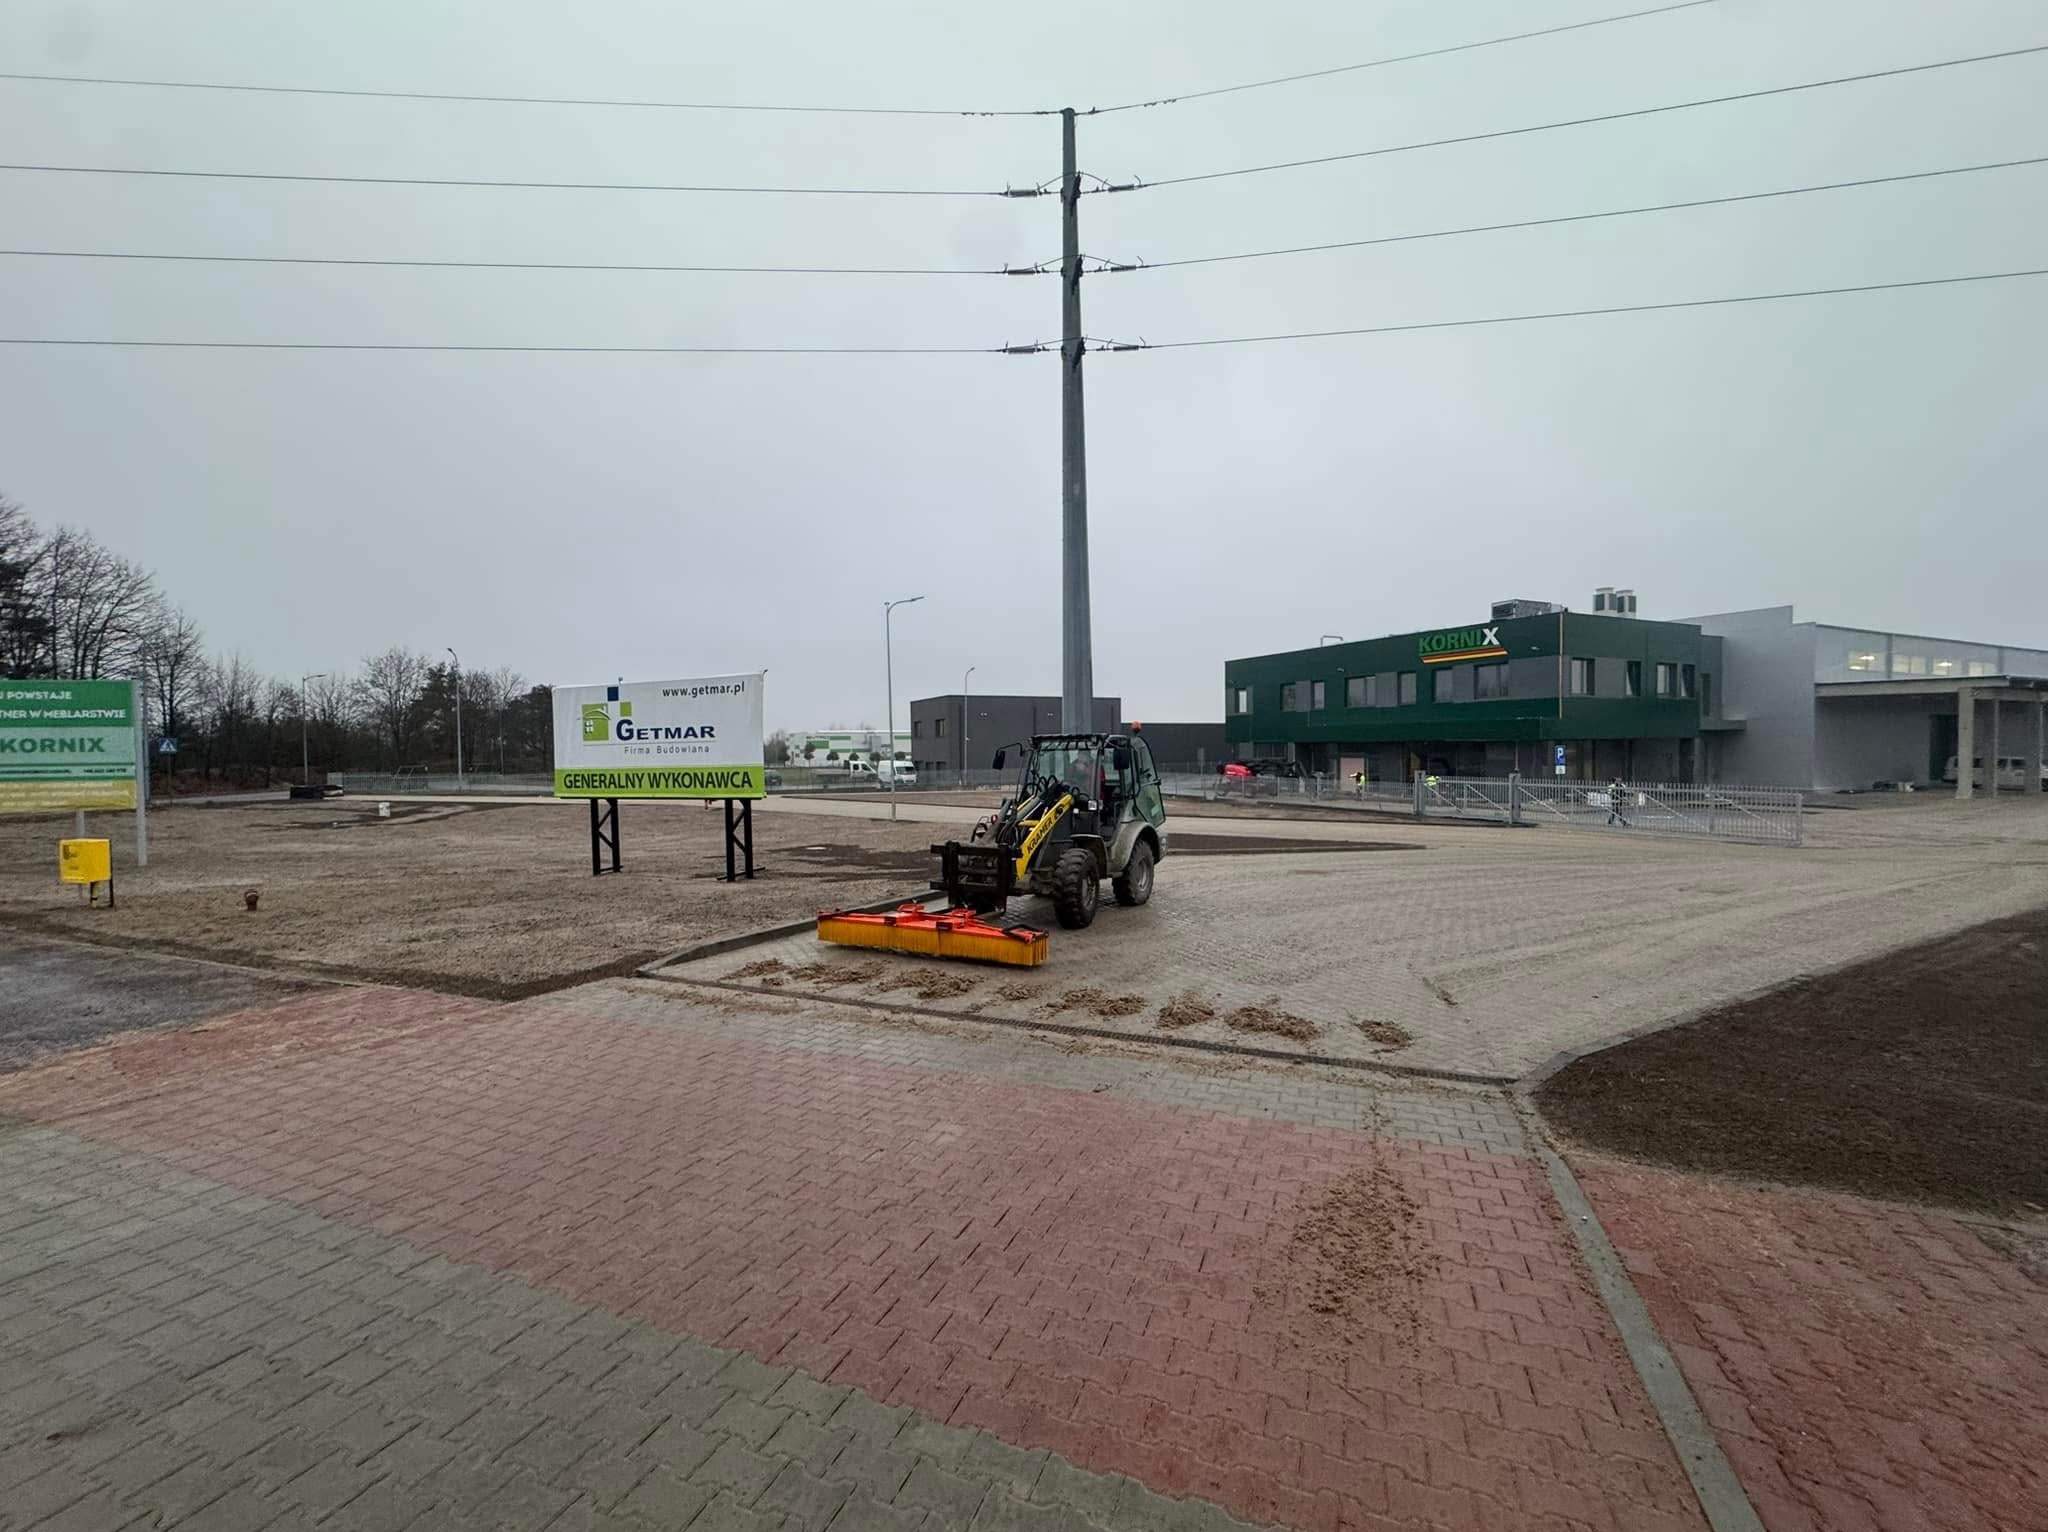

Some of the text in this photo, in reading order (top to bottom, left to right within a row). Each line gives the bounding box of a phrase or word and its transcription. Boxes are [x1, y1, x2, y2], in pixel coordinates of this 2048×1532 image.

[1419, 627, 1500, 654] KORNIX
[7, 691, 72, 700] POWSTAJE
[662, 681, 745, 698] www.getmar.pl
[29, 709, 42, 719] W
[43, 709, 127, 719] MEBLARSTWIE
[0, 737, 106, 753] KORNIX
[624, 746, 650, 755] Firma
[1557, 747, 1564, 760] P
[563, 771, 753, 790] GENERALNY WYKONAWCA
